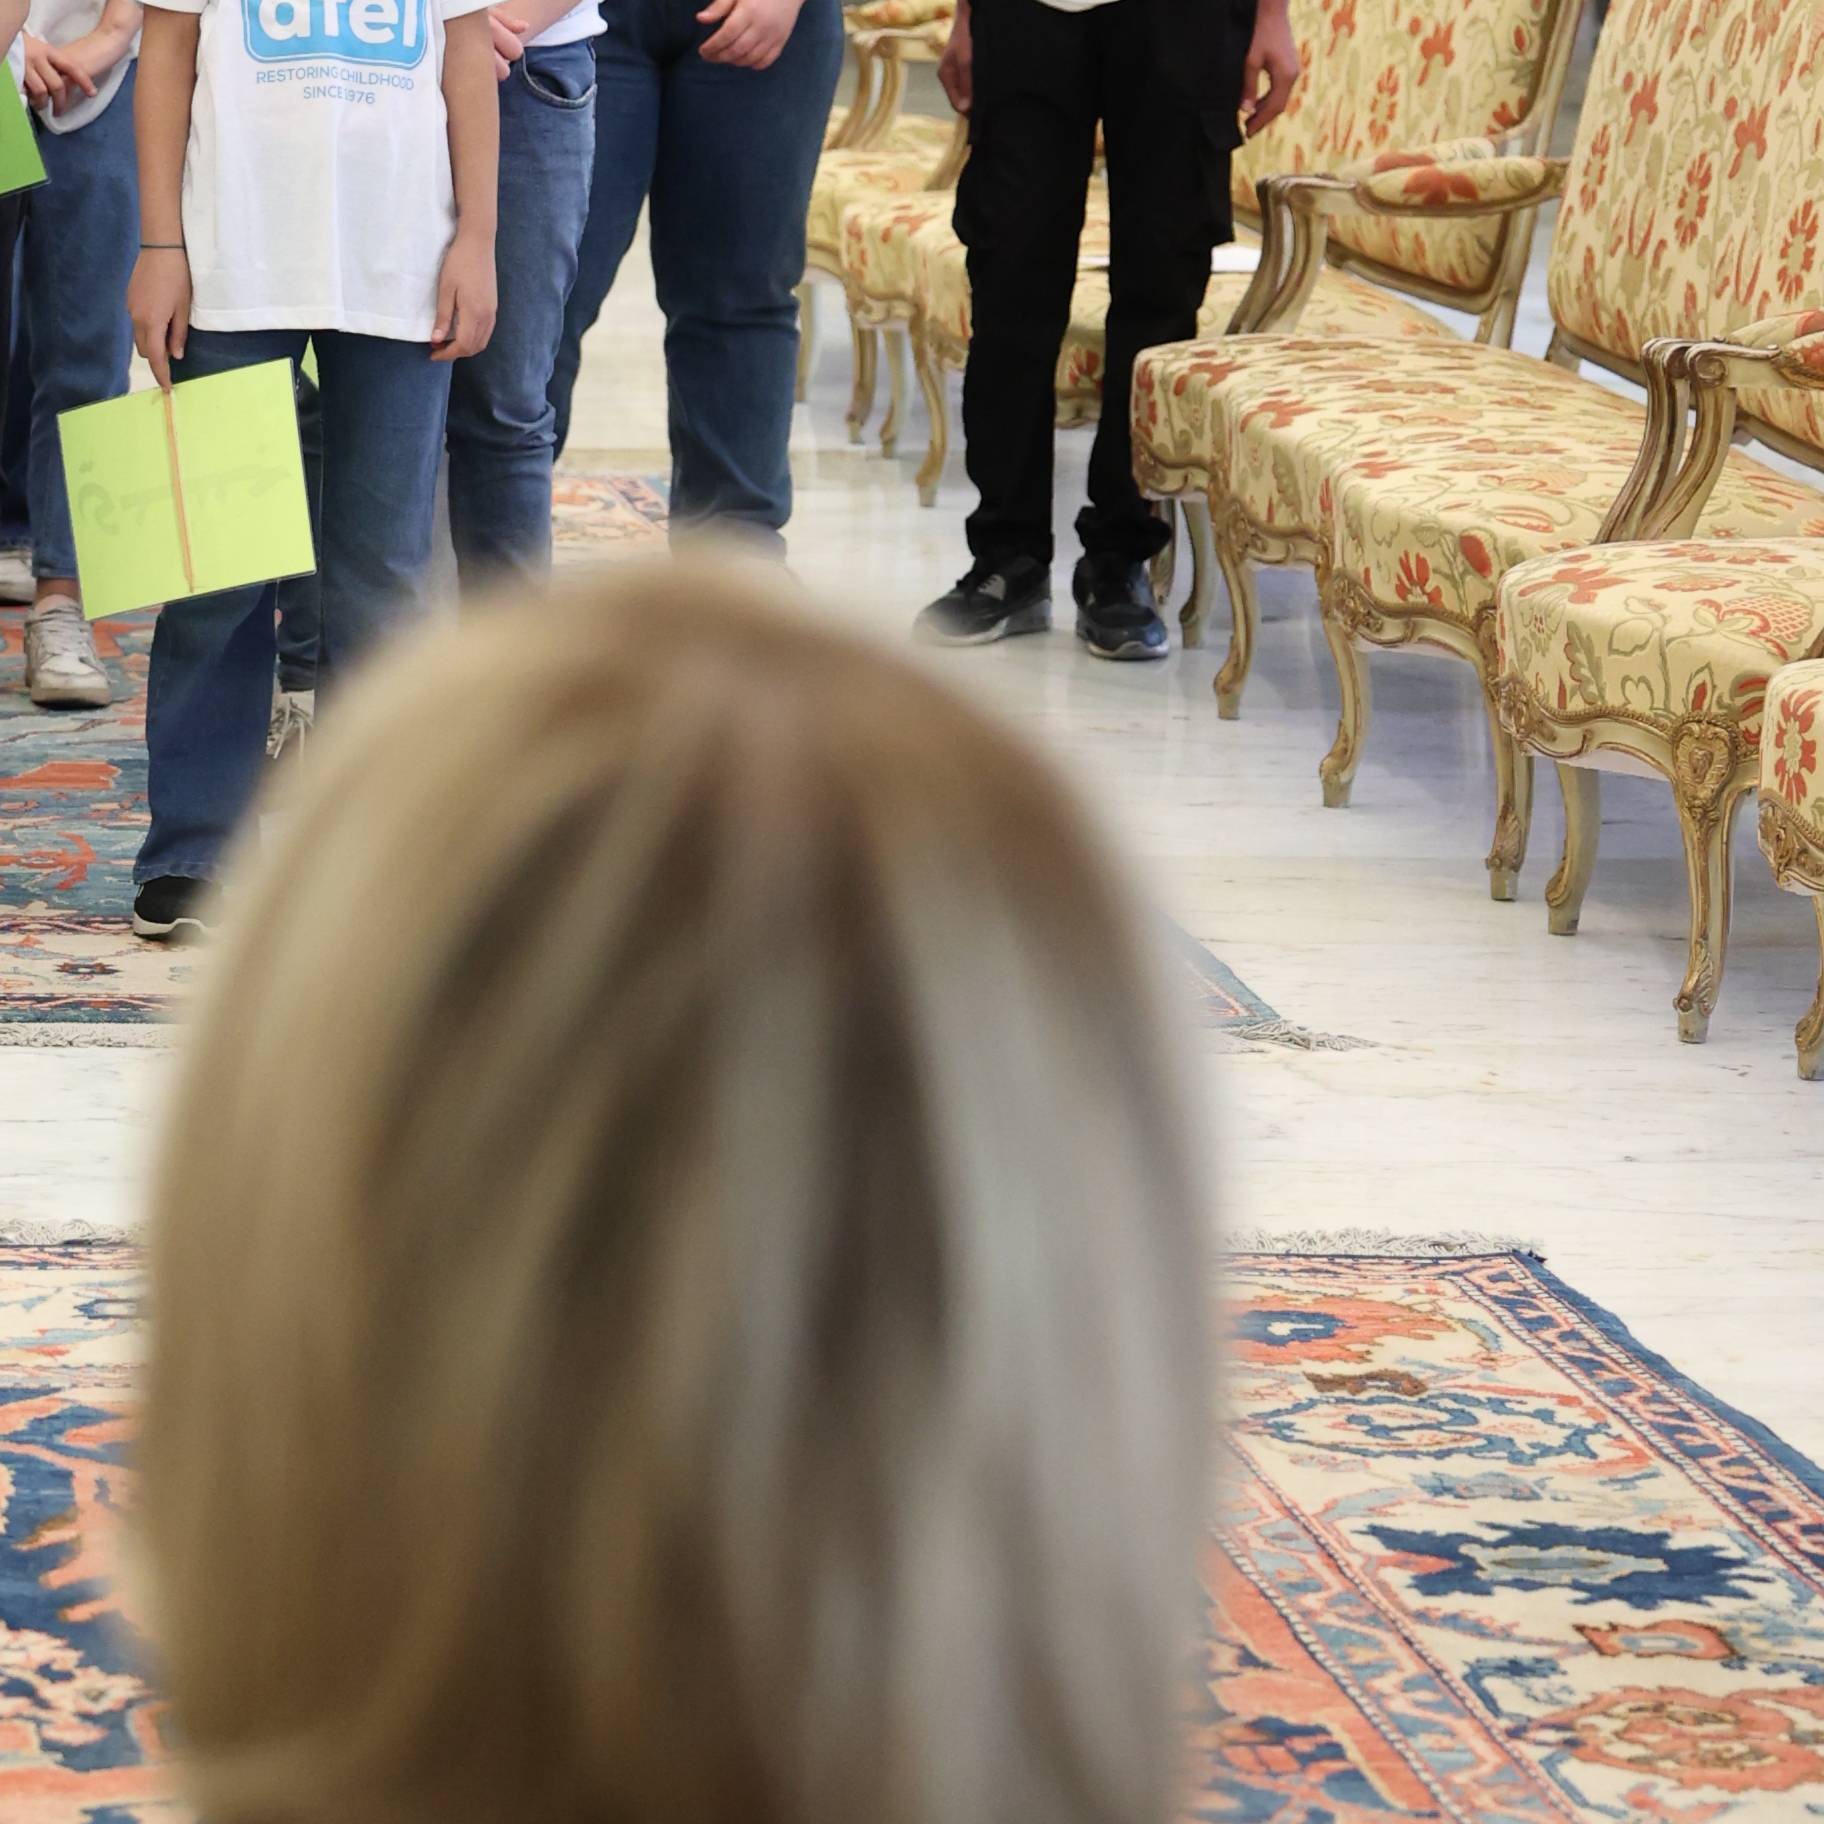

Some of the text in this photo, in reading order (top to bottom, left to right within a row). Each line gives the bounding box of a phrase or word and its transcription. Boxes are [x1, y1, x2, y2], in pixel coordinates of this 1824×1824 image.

[256, 66, 414, 90] RESTORING CHILDHOOD
[303, 85, 343, 100] SINCE
